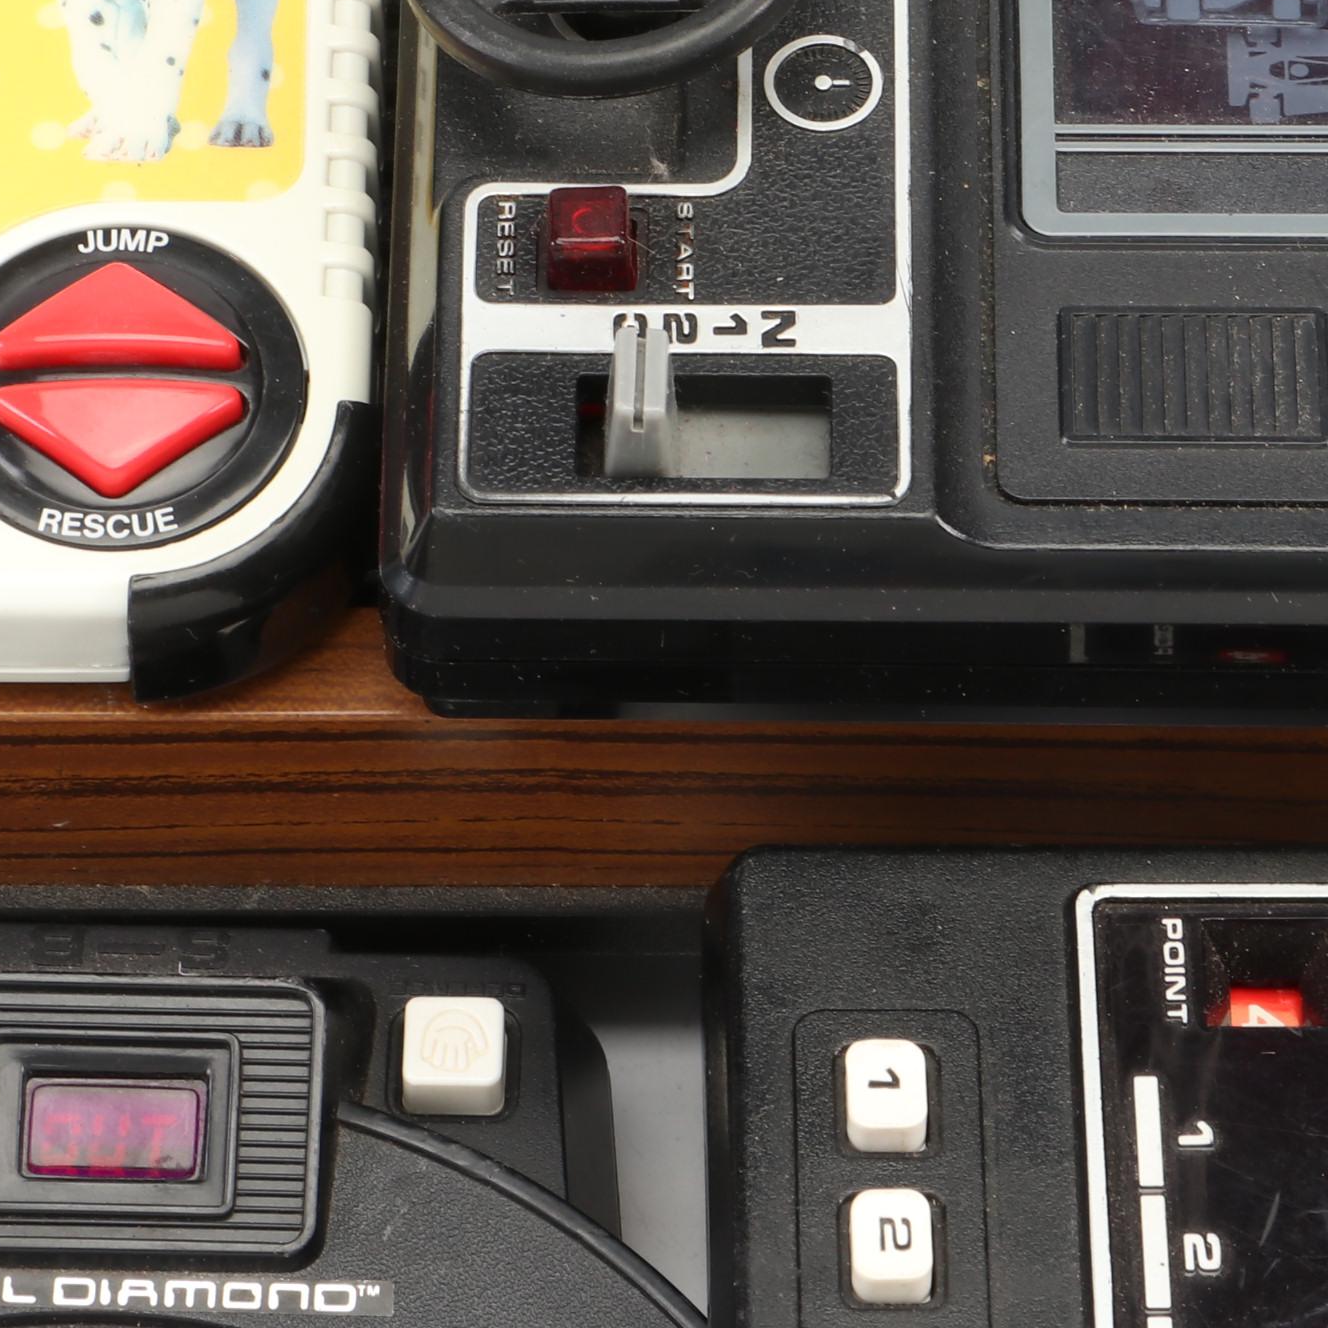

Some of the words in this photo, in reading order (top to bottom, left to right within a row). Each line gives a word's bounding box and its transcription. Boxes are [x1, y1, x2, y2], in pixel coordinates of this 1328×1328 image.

[76, 228, 170, 254] JUMP
[496, 200, 517, 297] RESET
[673, 201, 696, 301] START
[662, 312, 698, 344] 2
[712, 312, 749, 336] 1
[759, 309, 797, 349] N
[37, 507, 179, 539] RESCUE
[1160, 917, 1190, 1026] POINT
[867, 1067, 902, 1090] 1
[1177, 1119, 1217, 1150] 1
[878, 1216, 913, 1254] 2
[1183, 1232, 1223, 1275] 2
